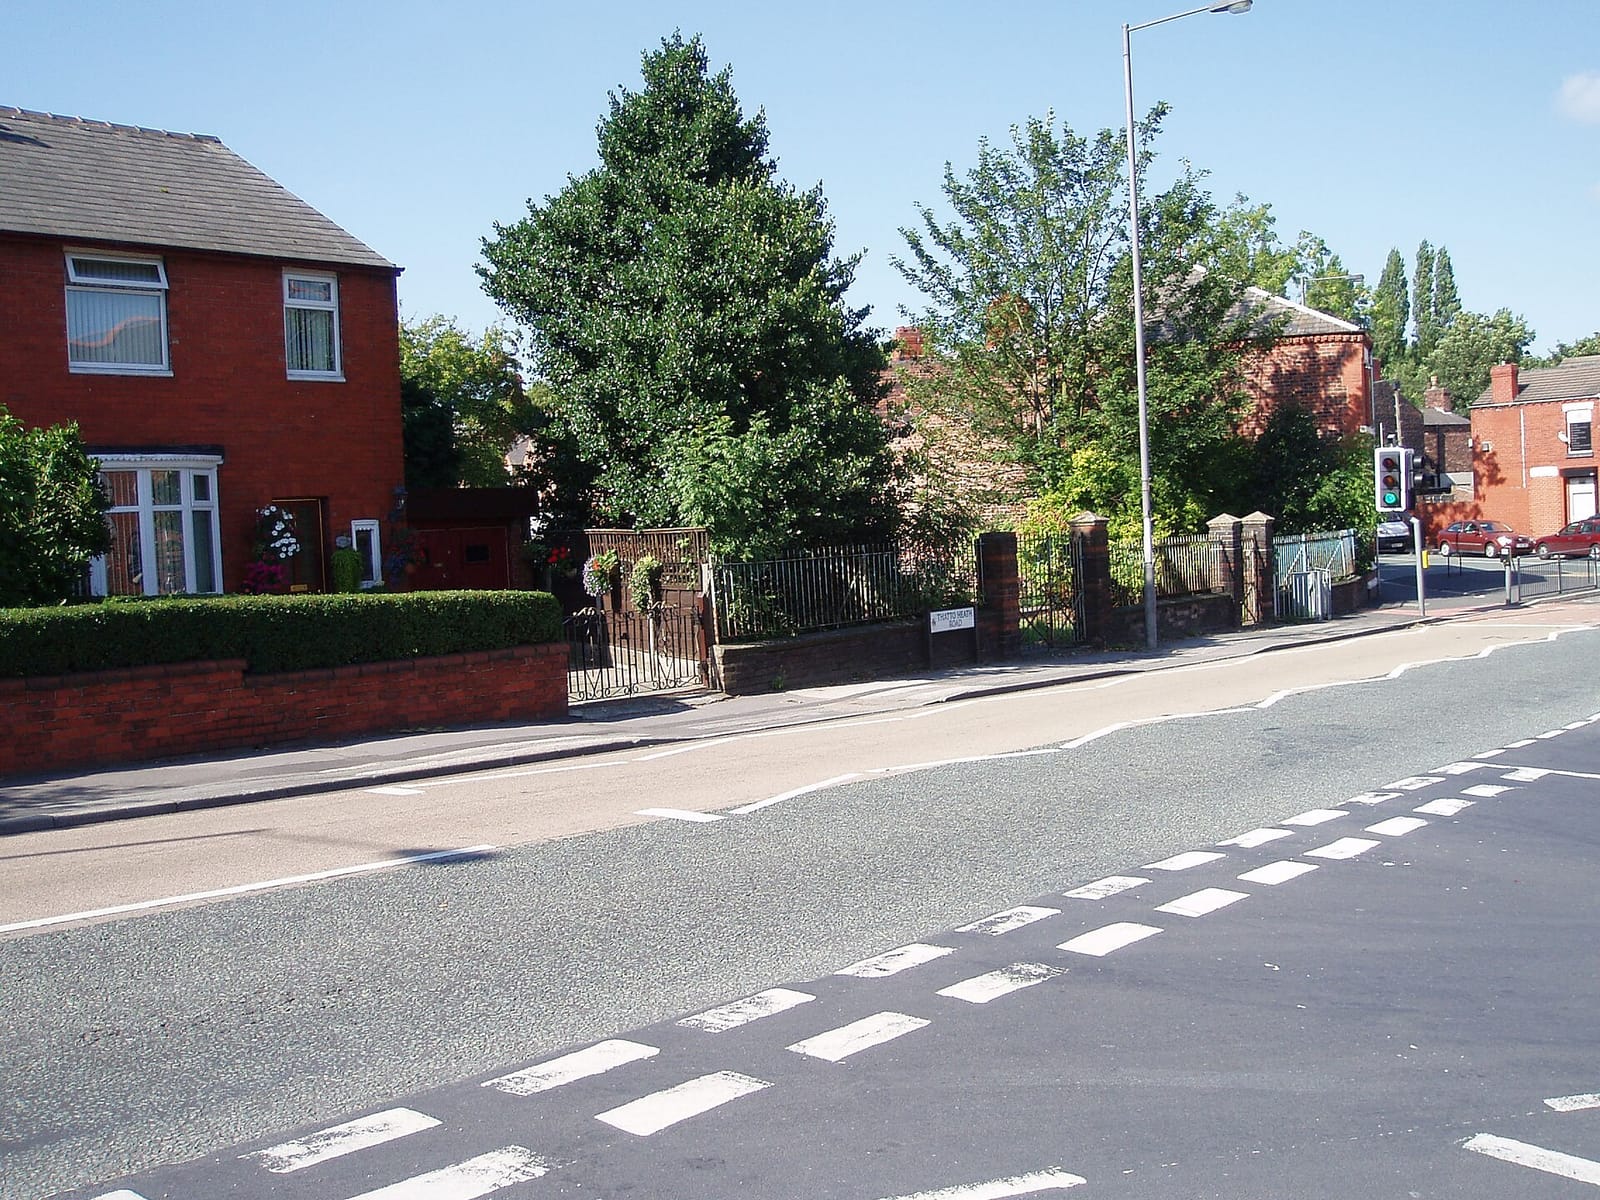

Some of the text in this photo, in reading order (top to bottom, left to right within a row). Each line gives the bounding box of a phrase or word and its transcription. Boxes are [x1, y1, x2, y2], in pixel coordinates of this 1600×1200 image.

[937, 609, 972, 621] THATTO HEATH
[949, 619, 963, 627] ROAD
